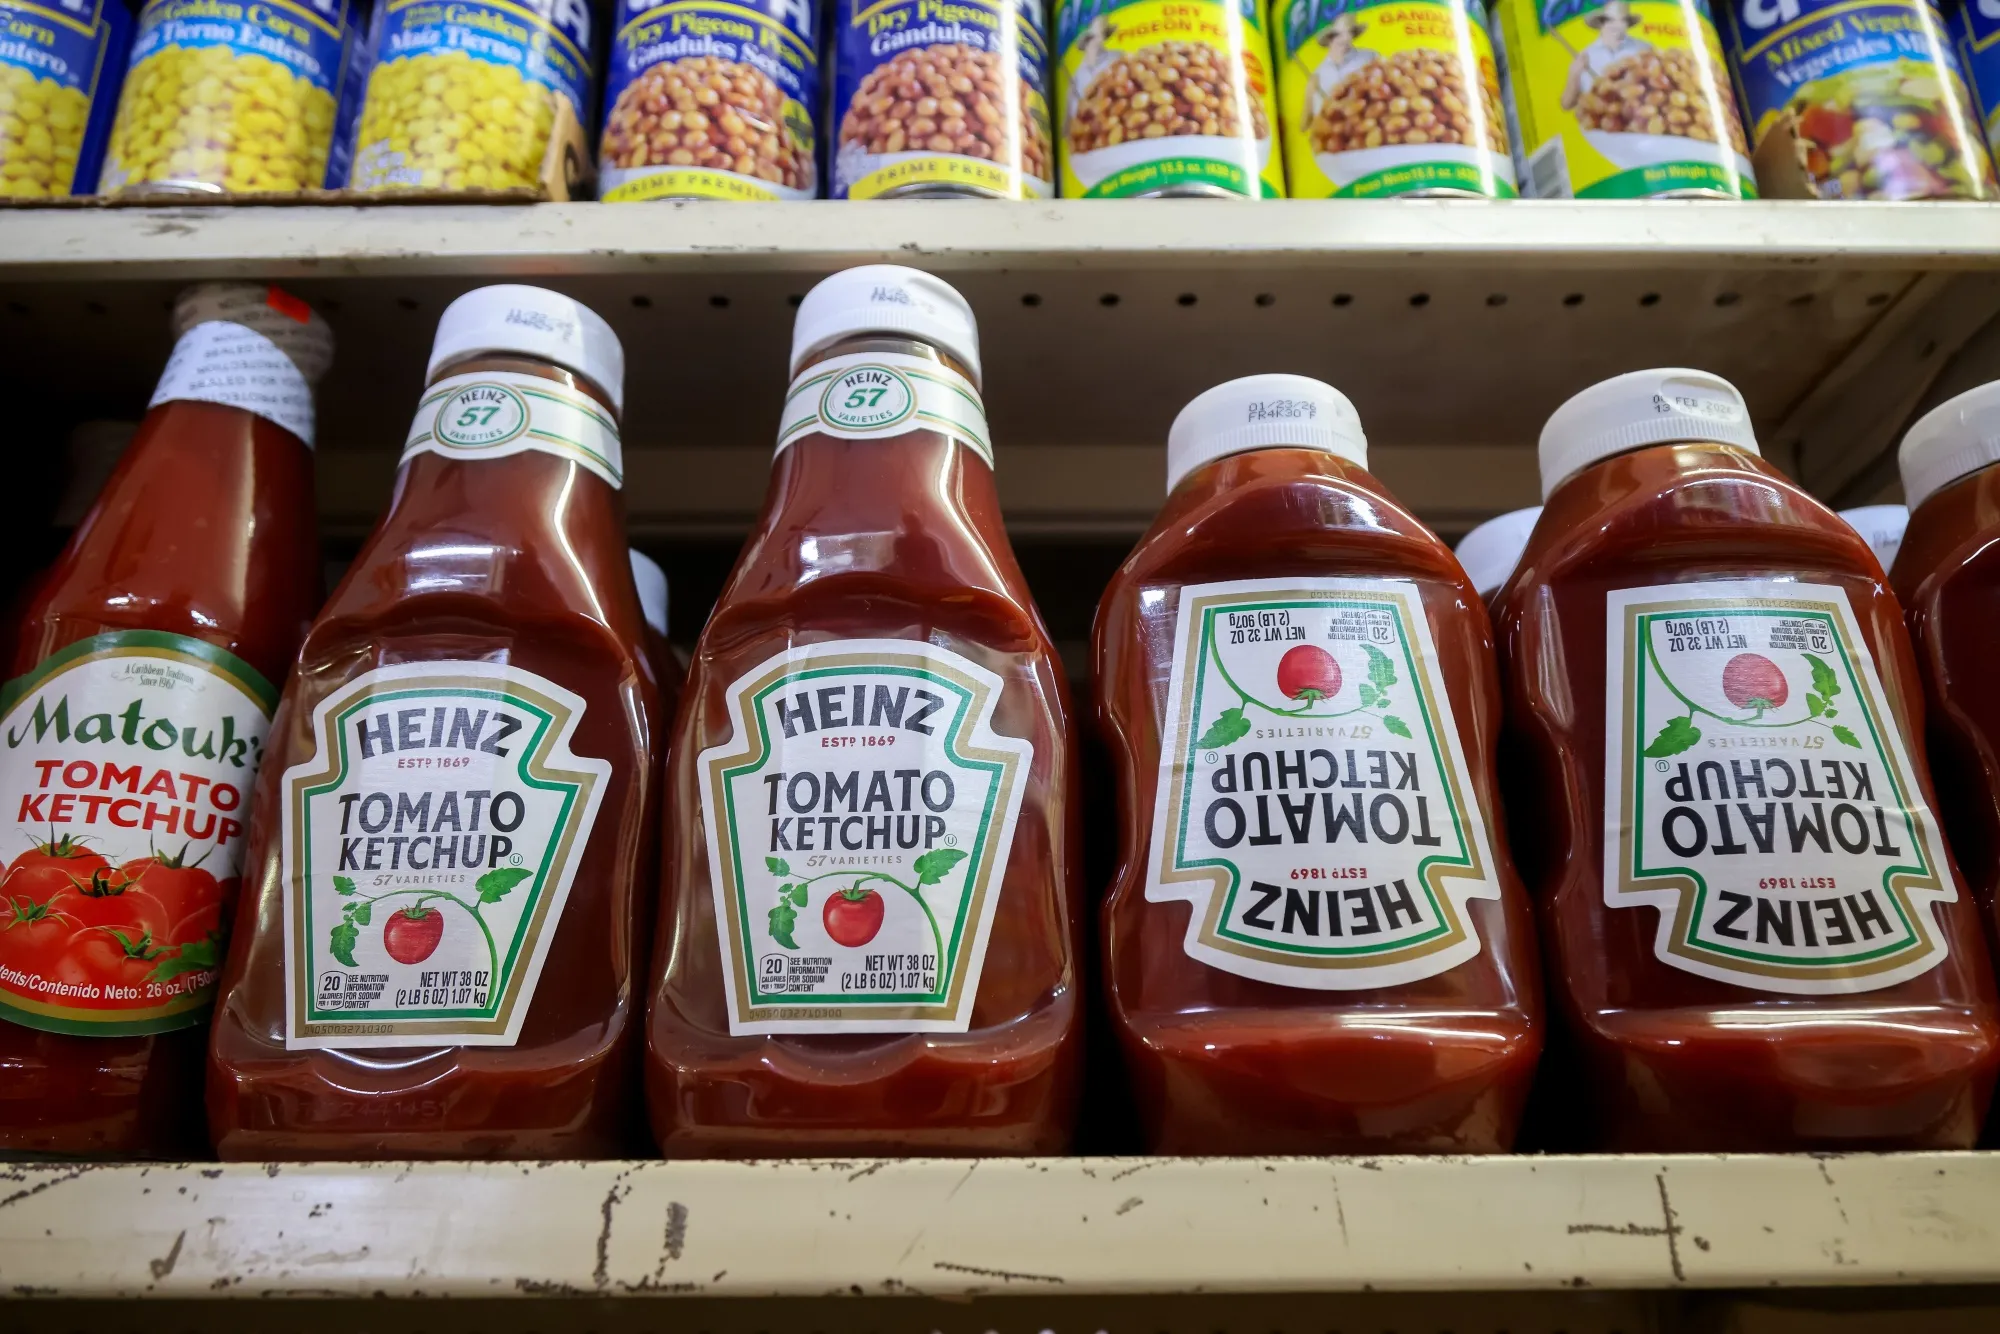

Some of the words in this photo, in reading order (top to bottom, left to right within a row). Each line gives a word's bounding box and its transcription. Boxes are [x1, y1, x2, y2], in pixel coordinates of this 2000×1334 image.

[671, 12, 754, 42] Pigeon
[871, 22, 986, 56] Gandules
[628, 35, 737, 71] Gandules
[845, 372, 892, 387] HEINZ
[461, 390, 507, 404] HEINZ
[844, 388, 887, 408] 57
[1249, 400, 1316, 412] 01/23/26
[457, 406, 500, 426] 57
[838, 410, 893, 423] VARIETIES
[449, 428, 503, 441] VARIETIES
[1229, 613, 1255, 628] 907g
[1258, 611, 1276, 628] LB)
[1278, 610, 1290, 626] (2
[1665, 620, 1694, 636] 907g
[1696, 618, 1715, 635] LB)
[1717, 617, 1730, 634] (2
[1230, 630, 1244, 644] OZ
[1247, 628, 1261, 642] 32
[1264, 627, 1282, 641] WT
[1285, 626, 1306, 640] NET
[1373, 627, 1388, 640] 20
[1668, 638, 1684, 652] OZ
[1686, 637, 1702, 650] 32
[1705, 636, 1724, 649] WT
[1727, 635, 1748, 648] NET
[1811, 636, 1827, 649] 20
[132, 663, 165, 676] Caribbean
[139, 675, 157, 687] Since
[774, 684, 945, 739] HEINZ
[356, 706, 523, 760] HEINZ
[1255, 727, 1346, 739] VARIETIES
[1350, 725, 1373, 739] 57
[861, 735, 896, 748] 1869
[1707, 737, 1799, 748] VARIETIES
[1803, 735, 1825, 749] 57
[437, 757, 470, 769] 1869
[1211, 748, 1421, 793] KETCHUP
[35, 760, 240, 812] TOMATO
[1665, 758, 1875, 803] KETCHUP
[763, 769, 955, 817] TOMATO
[17, 793, 243, 846] KETCHUP
[338, 790, 525, 836] TOMATO
[1204, 792, 1442, 849] TOMATO
[769, 814, 946, 852] KETCHUP
[1661, 801, 1901, 858] TOMATO
[338, 834, 513, 872] KETCHUP
[806, 854, 827, 867] 57
[829, 854, 903, 866] VARIETIES
[372, 874, 394, 886] 57
[395, 873, 466, 885] VARIETIES
[1291, 868, 1327, 880] 1869
[1759, 878, 1795, 890] 1869
[1242, 879, 1423, 937] HEINZ
[1713, 889, 1894, 948] HEINZ
[766, 958, 782, 974] 20
[789, 957, 801, 966] SEE
[802, 957, 832, 966] NUTRITION
[865, 955, 884, 971] NET
[887, 955, 904, 971] WT
[906, 954, 918, 971] 38
[922, 955, 935, 971] OZ
[789, 966, 829, 975] INFORMATION
[324, 976, 340, 991] 20
[348, 975, 359, 983] SEE
[360, 974, 389, 983] NUTRITION
[420, 972, 438, 988] NET
[441, 972, 457, 987] WT
[459, 972, 471, 987] 38
[474, 971, 488, 987] OZ
[789, 975, 801, 983] FOR
[802, 975, 825, 983] SODIUM
[841, 972, 852, 992] (2
[854, 973, 868, 989] LB
[869, 973, 876, 989] 6
[879, 972, 896, 992] OZ)
[900, 972, 920, 988] 1.07
[923, 973, 935, 992] kg
[105, 985, 142, 1000] Neto:
[147, 983, 162, 998] 26
[166, 982, 184, 996] oz.
[347, 983, 385, 991] INFORMATION
[788, 984, 815, 993] CONTENT
[319, 992, 343, 1000] CALORIES
[358, 992, 381, 1000] SODIUM
[395, 989, 407, 1008] (2
[408, 990, 420, 1005] LB
[423, 990, 429, 1004] 6
[432, 989, 449, 1007] OZ)
[451, 988, 470, 1004] 1.07
[473, 988, 487, 1007] kg
[344, 1001, 370, 1009] CONTENT
